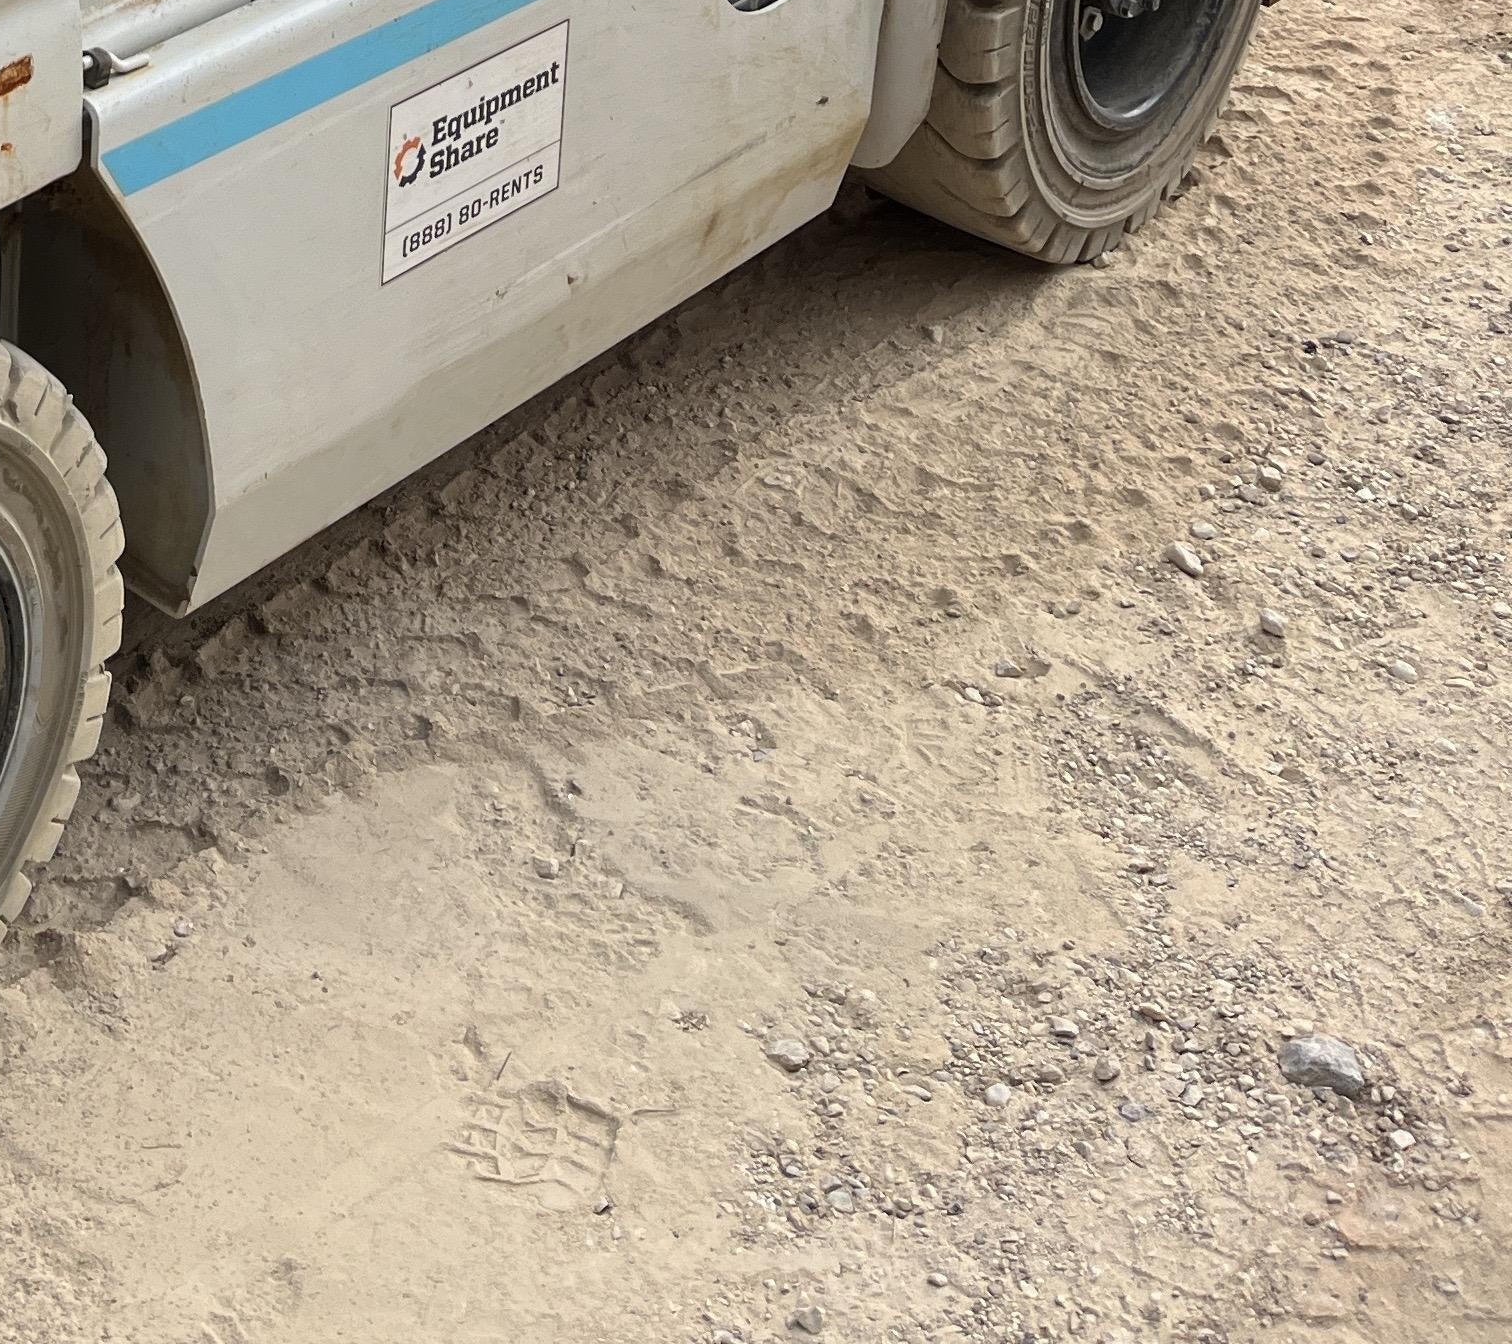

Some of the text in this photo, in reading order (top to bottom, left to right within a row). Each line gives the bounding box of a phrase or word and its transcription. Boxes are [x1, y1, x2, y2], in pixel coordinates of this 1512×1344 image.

[431, 60, 561, 148] Equipment
[429, 126, 500, 179] Share
[401, 164, 545, 258] (888) 80-RENTS
